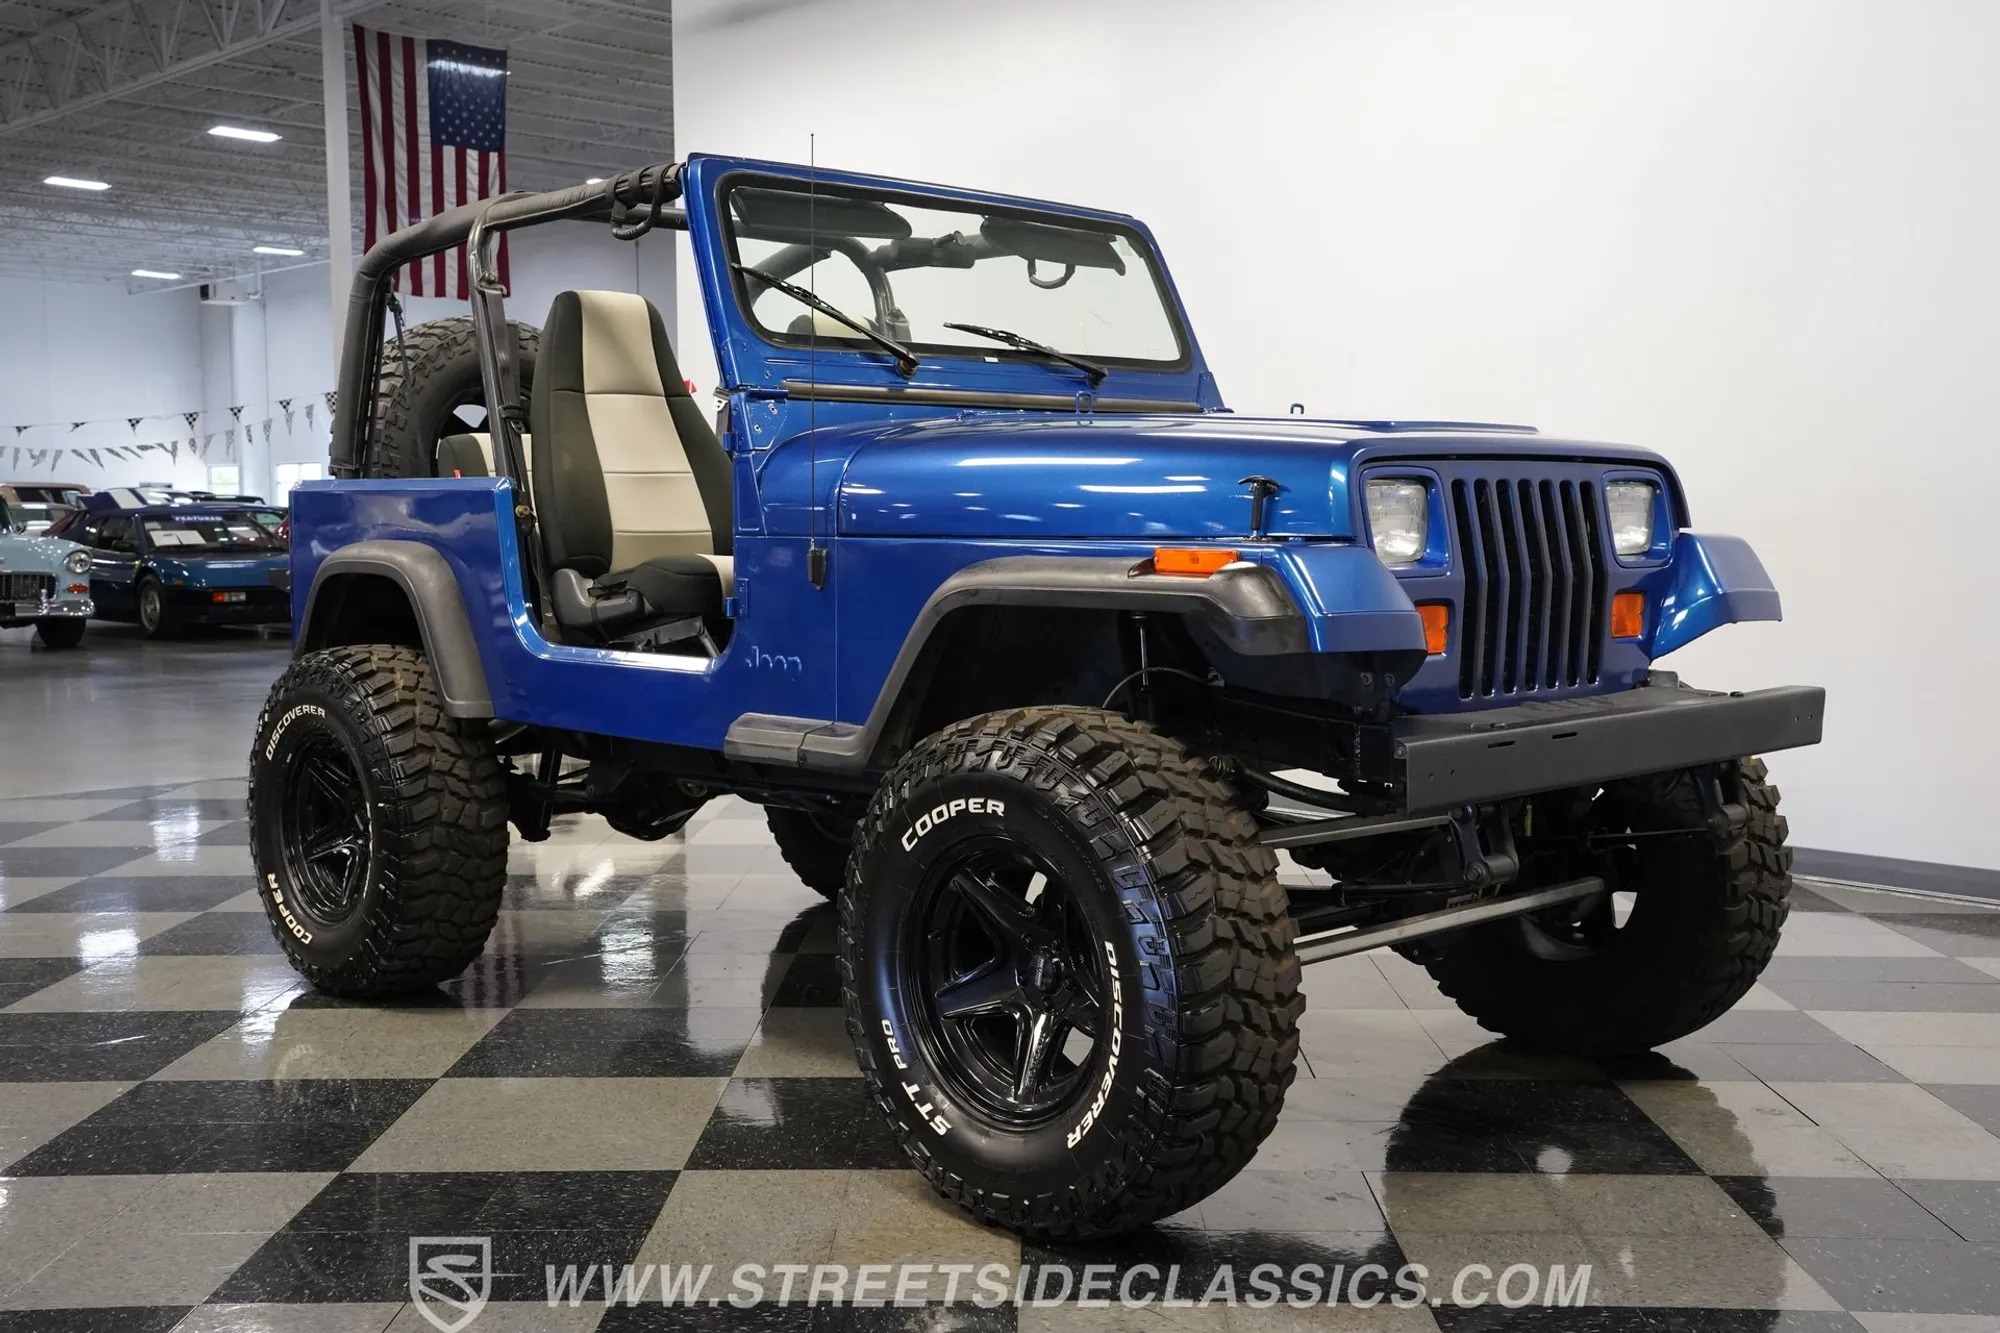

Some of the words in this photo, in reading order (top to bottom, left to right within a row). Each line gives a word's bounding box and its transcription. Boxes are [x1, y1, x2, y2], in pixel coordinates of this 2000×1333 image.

[265, 703, 326, 761] DISCOVERER
[900, 796, 1006, 853] COOPER
[266, 872, 314, 946] COOPER
[881, 1018, 908, 1070] PRO
[1066, 939, 1123, 1150] DISCOVERER
[900, 1080, 954, 1137] STT
